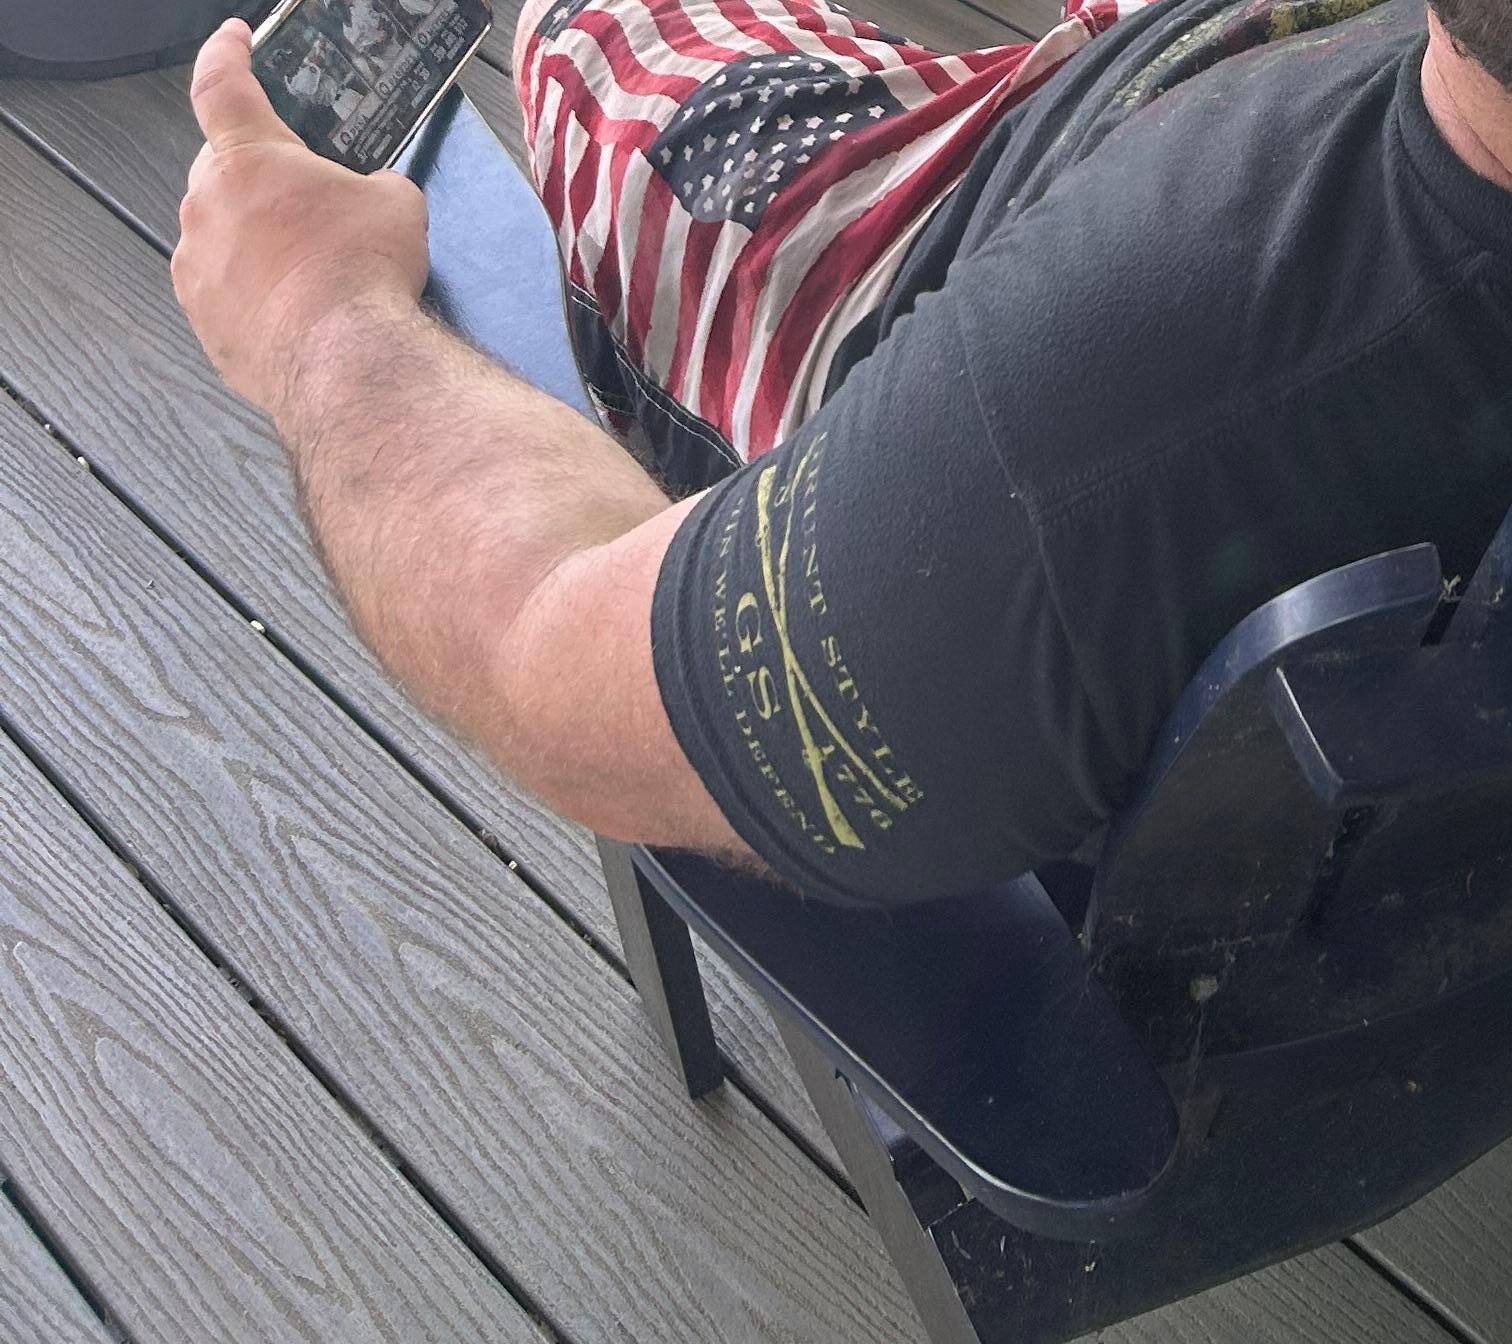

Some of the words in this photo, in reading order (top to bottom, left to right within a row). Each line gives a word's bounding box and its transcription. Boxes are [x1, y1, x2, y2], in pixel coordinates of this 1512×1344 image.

[735, 592, 782, 720] GS
[802, 446, 829, 616] RUNT
[820, 635, 925, 804] STYLE
